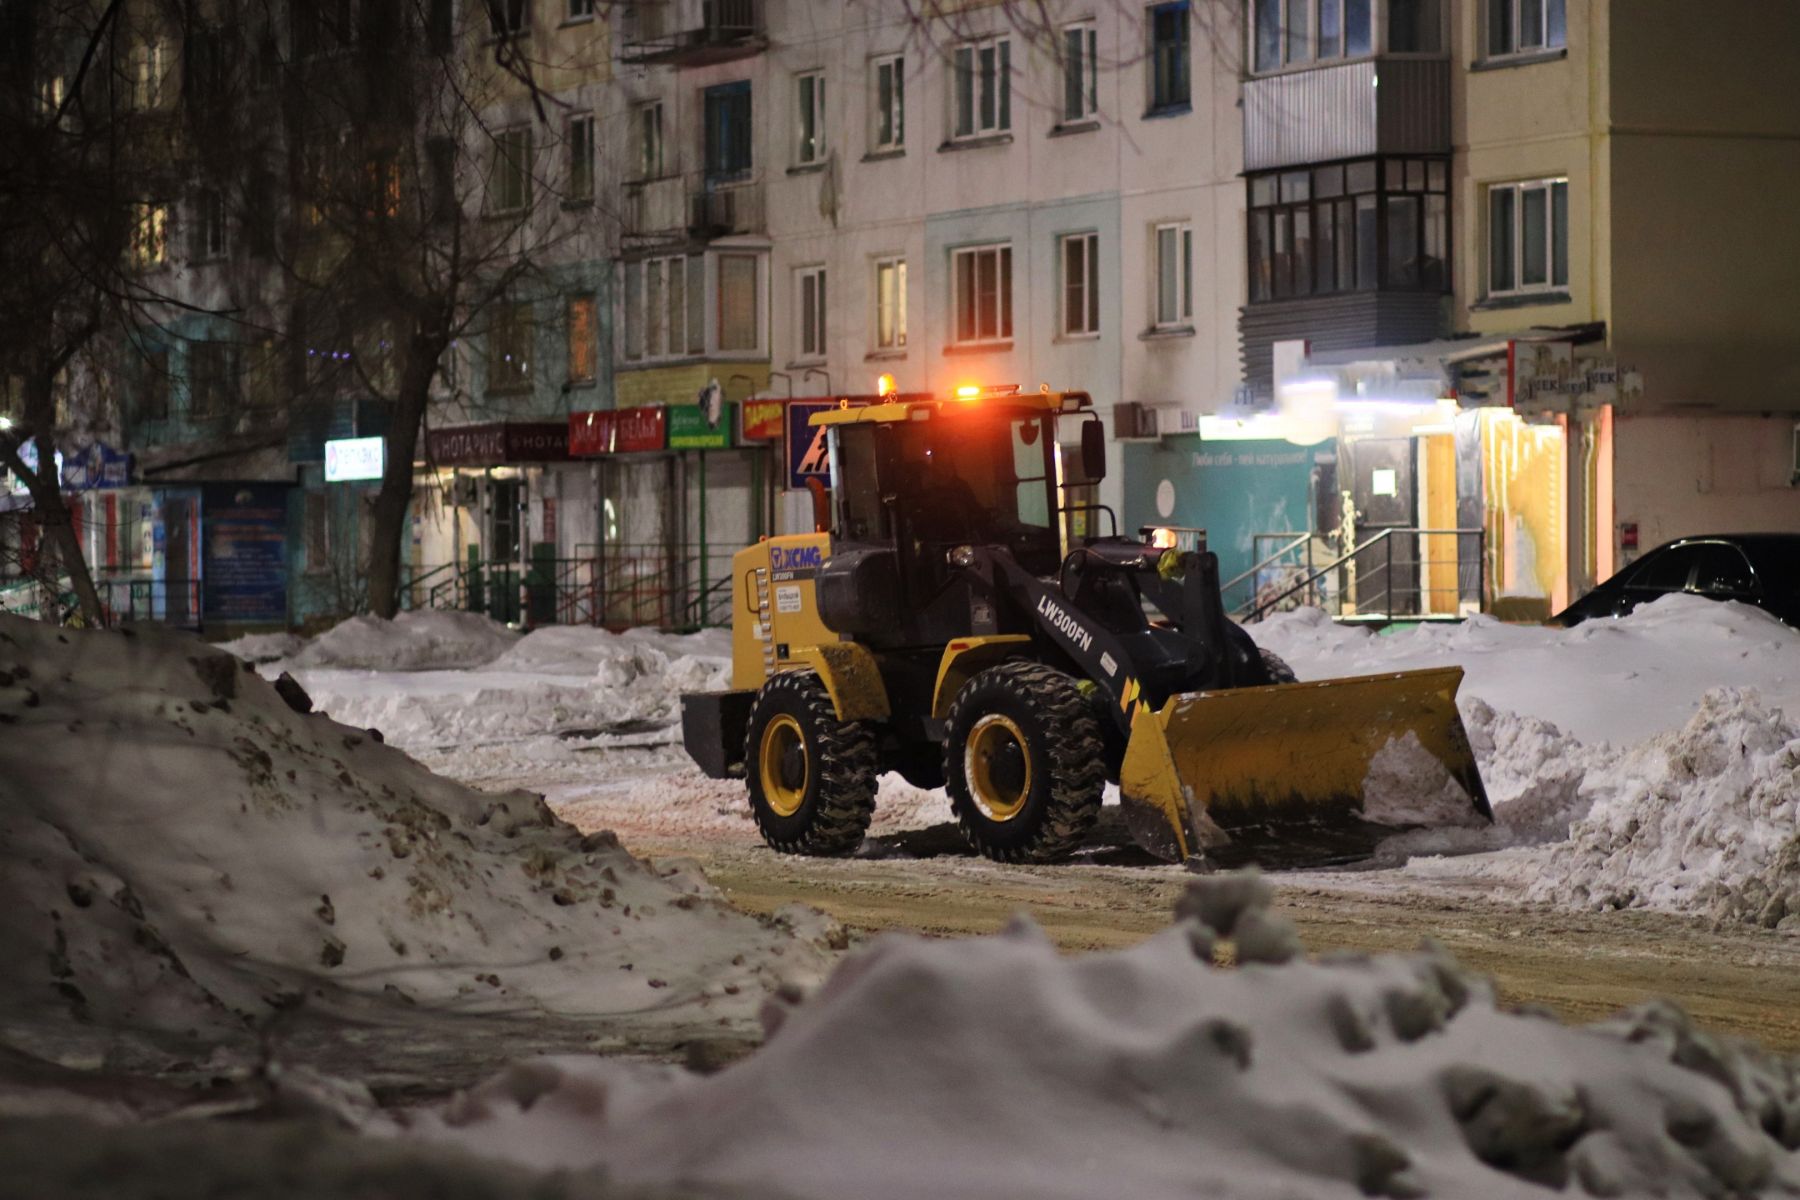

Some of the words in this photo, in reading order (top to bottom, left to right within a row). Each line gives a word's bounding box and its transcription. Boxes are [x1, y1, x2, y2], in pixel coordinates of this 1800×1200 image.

[441, 431, 504, 458] НОТАРИУС
[784, 546, 822, 569] XCMG
[1037, 595, 1093, 652] LW300FN
